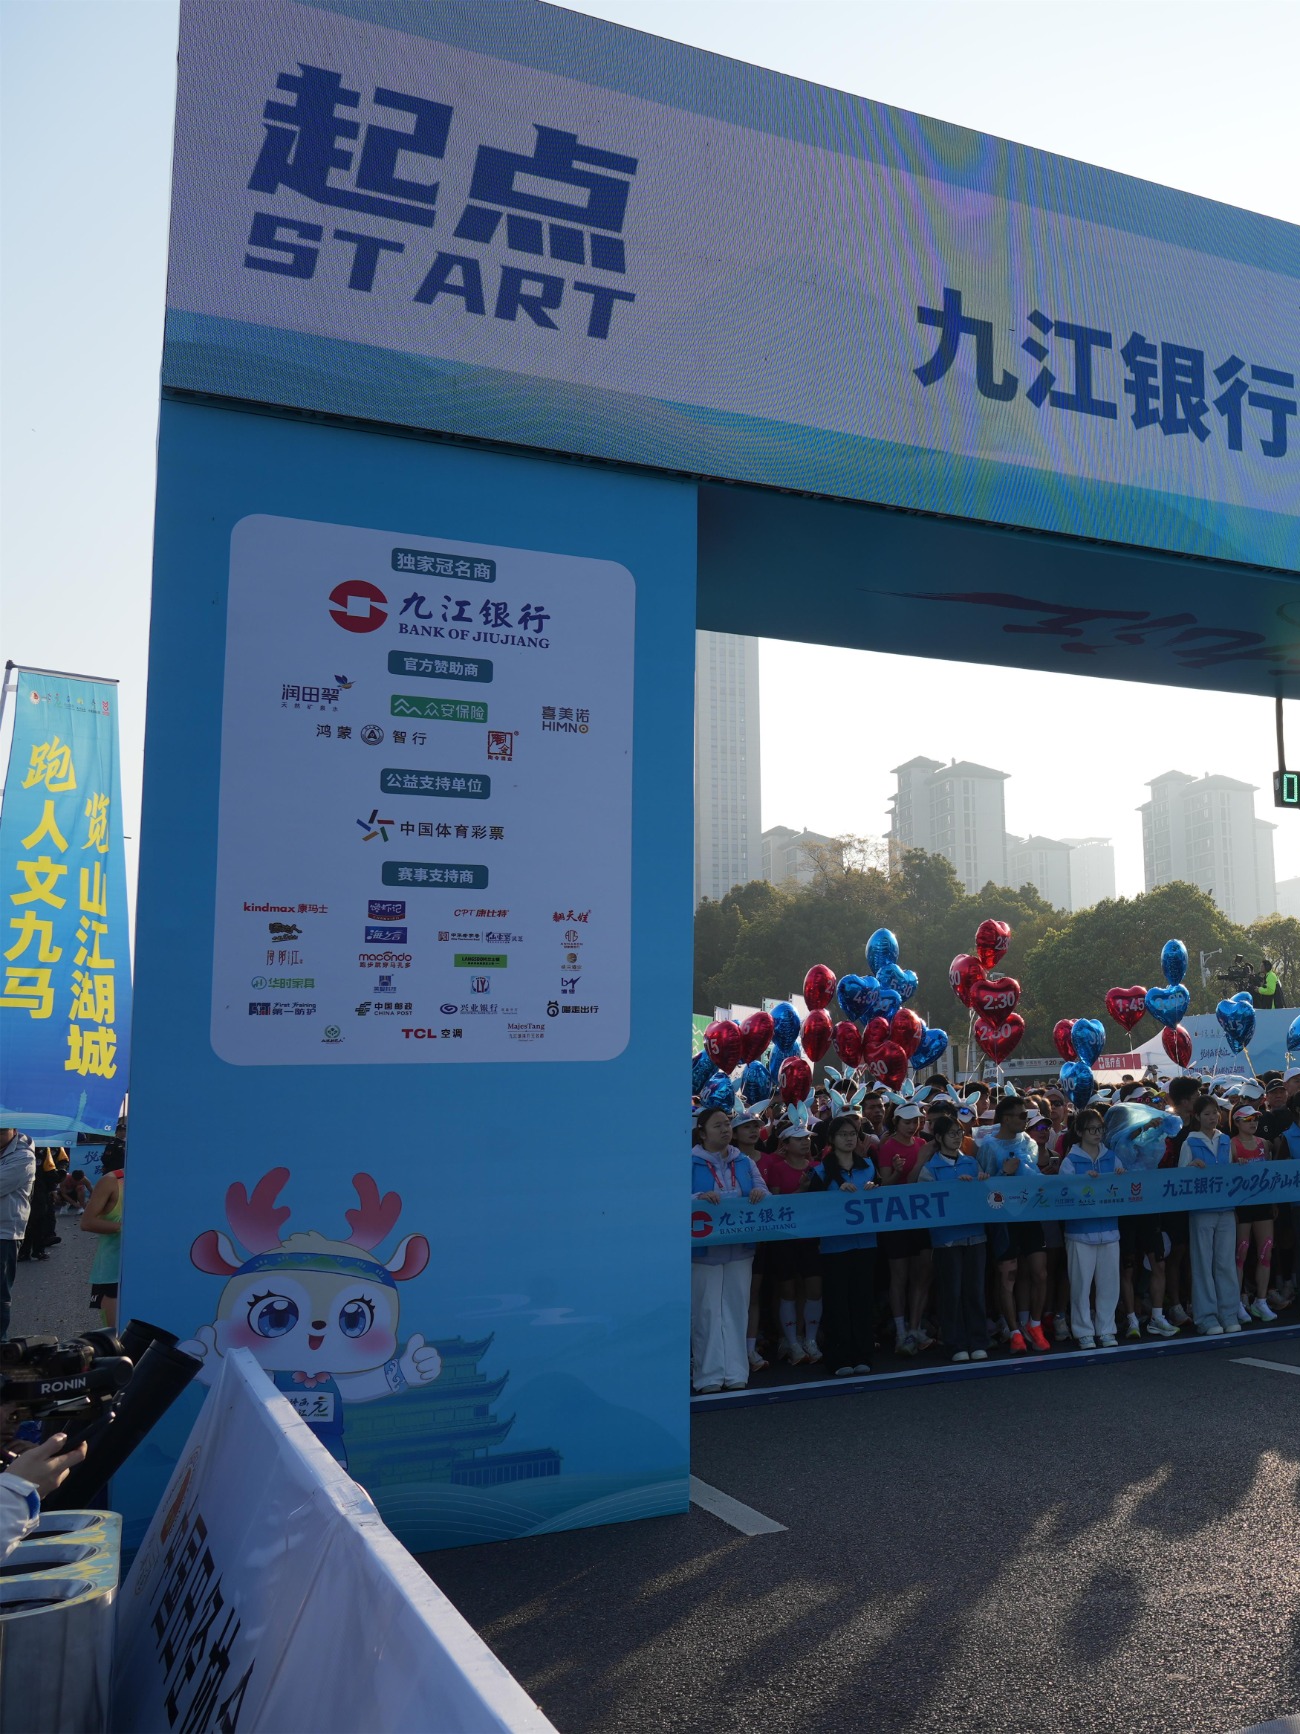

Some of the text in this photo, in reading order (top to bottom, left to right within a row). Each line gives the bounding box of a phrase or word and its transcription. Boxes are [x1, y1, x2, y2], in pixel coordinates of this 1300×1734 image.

[247, 62, 639, 274] 起点
[244, 212, 636, 340] START
[396, 552, 491, 581] 独家冠名商
[399, 591, 551, 634] 九江银行
[398, 623, 550, 649] BANK OF JIUJIANG
[403, 657, 479, 677] 官方赞助商
[282, 683, 340, 705] 润田翠
[424, 702, 485, 721] 众安保险
[541, 705, 591, 724] 喜美诺
[316, 724, 427, 746] 鸿蒙 智行
[386, 773, 483, 794] 公益支持单位
[400, 820, 505, 841] 中国体育彩票
[0, 735, 76, 1020] 跑人文九马
[397, 867, 475, 885] 赛事支持商
[243, 901, 328, 914] kindmax 康玛士
[454, 909, 475, 918] CPT
[64, 792, 118, 1080] 览山江湖城
[358, 951, 413, 962] macondo
[268, 977, 315, 989] 华时家具
[890, 979, 913, 998] 5:30
[374, 1002, 412, 1010] 中国邮政
[852, 988, 880, 1005] 4:30
[983, 991, 1016, 1010] 2:30
[1116, 997, 1145, 1013] 1:45
[272, 1008, 317, 1016] 第一防护
[460, 1003, 498, 1012] 兴业银行
[401, 1028, 463, 1039] TCL 空调
[718, 1206, 795, 1227] 九江银行
[843, 1191, 950, 1226] START
[756, 1222, 797, 1232] JIUJIANG
[41, 1377, 87, 1394] RONIN
